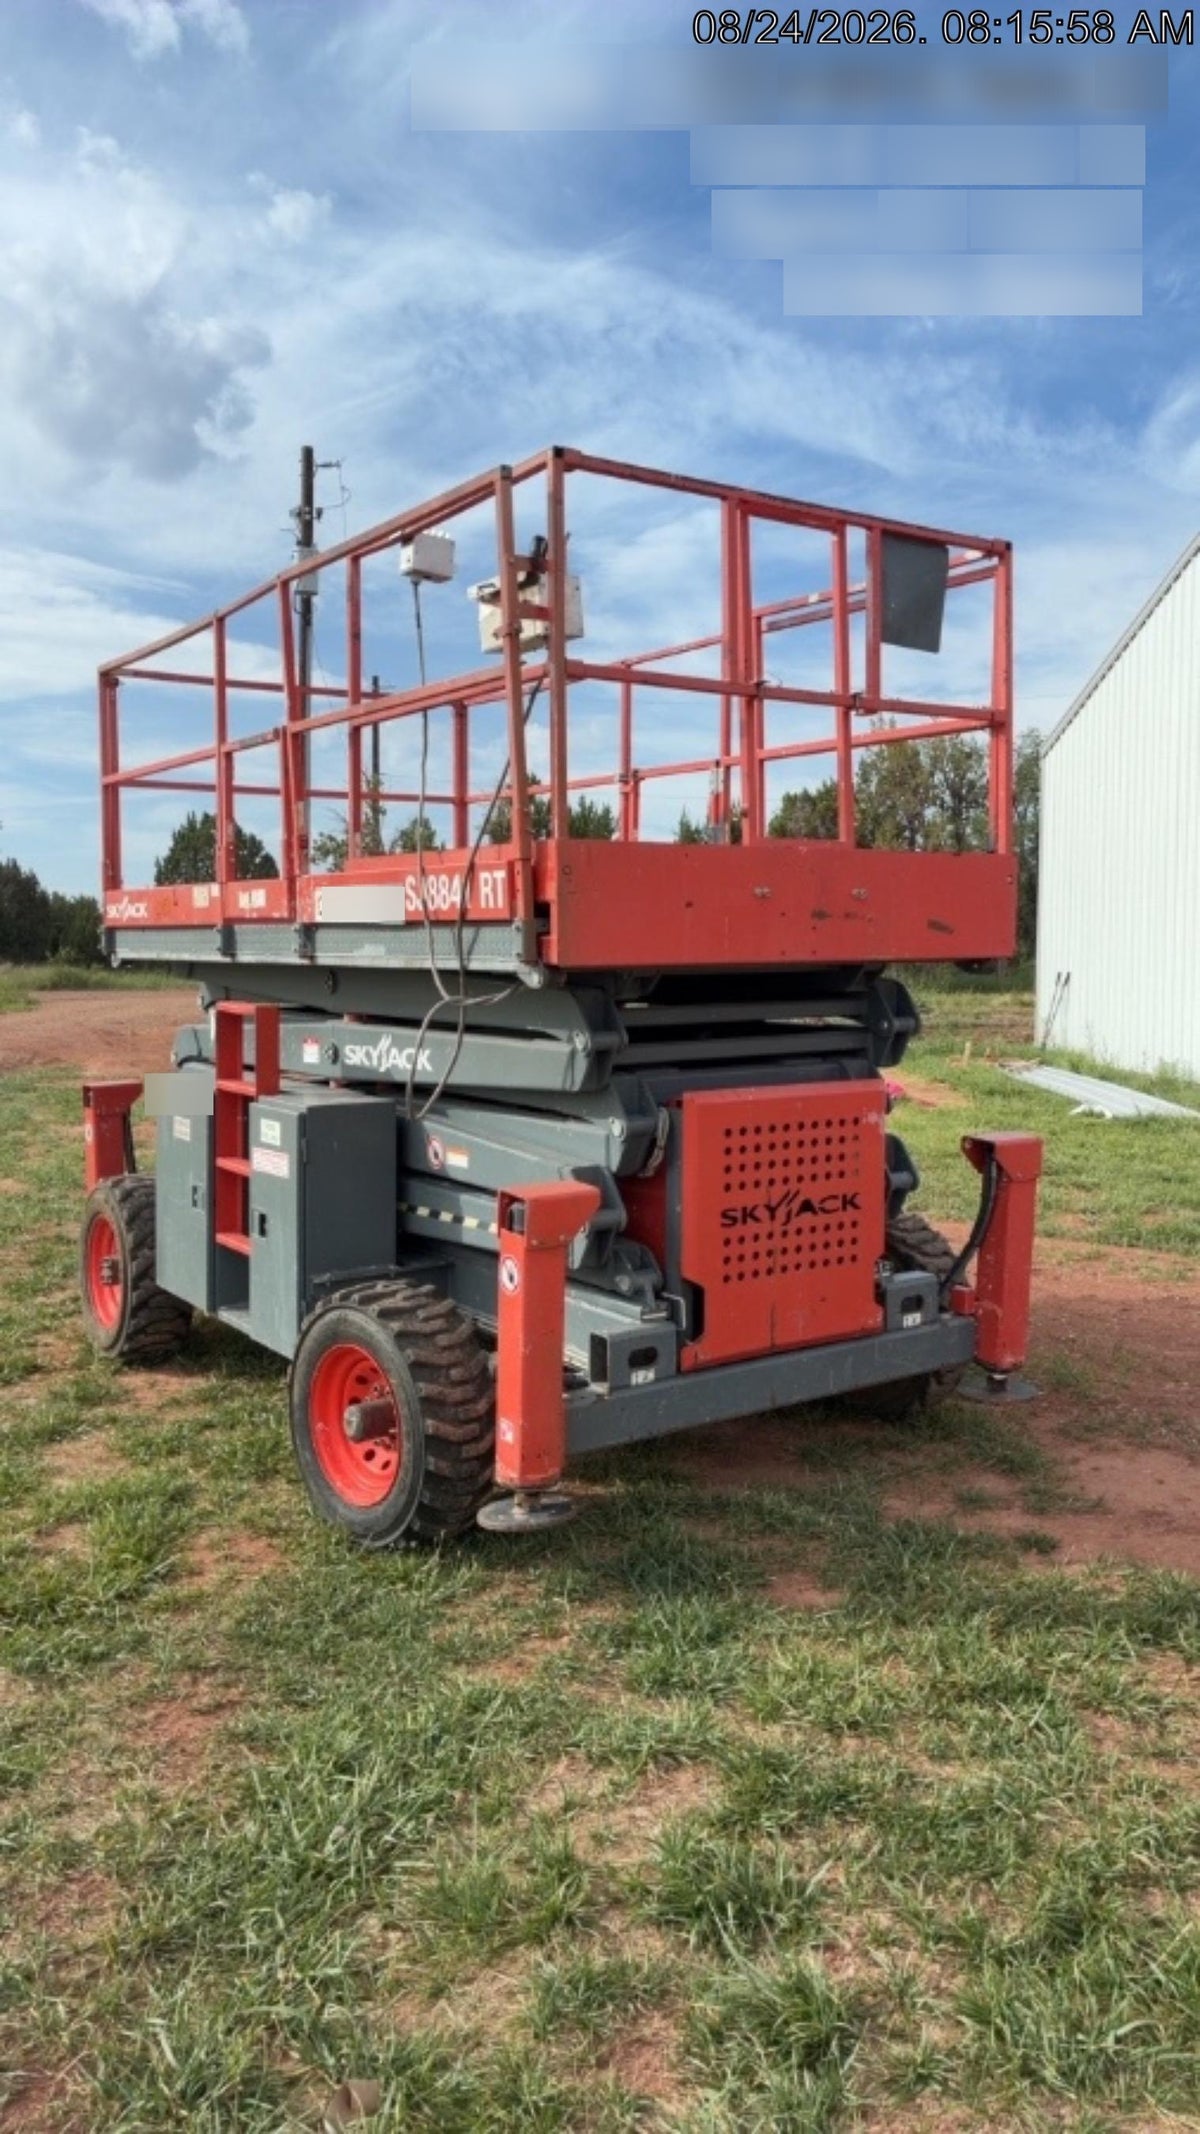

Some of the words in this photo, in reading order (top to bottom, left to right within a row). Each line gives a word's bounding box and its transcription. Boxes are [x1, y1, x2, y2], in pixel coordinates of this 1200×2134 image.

[479, 869, 506, 910] RT
[343, 1032, 432, 1072] SKYJACK
[721, 1189, 861, 1228] SKYJACK
